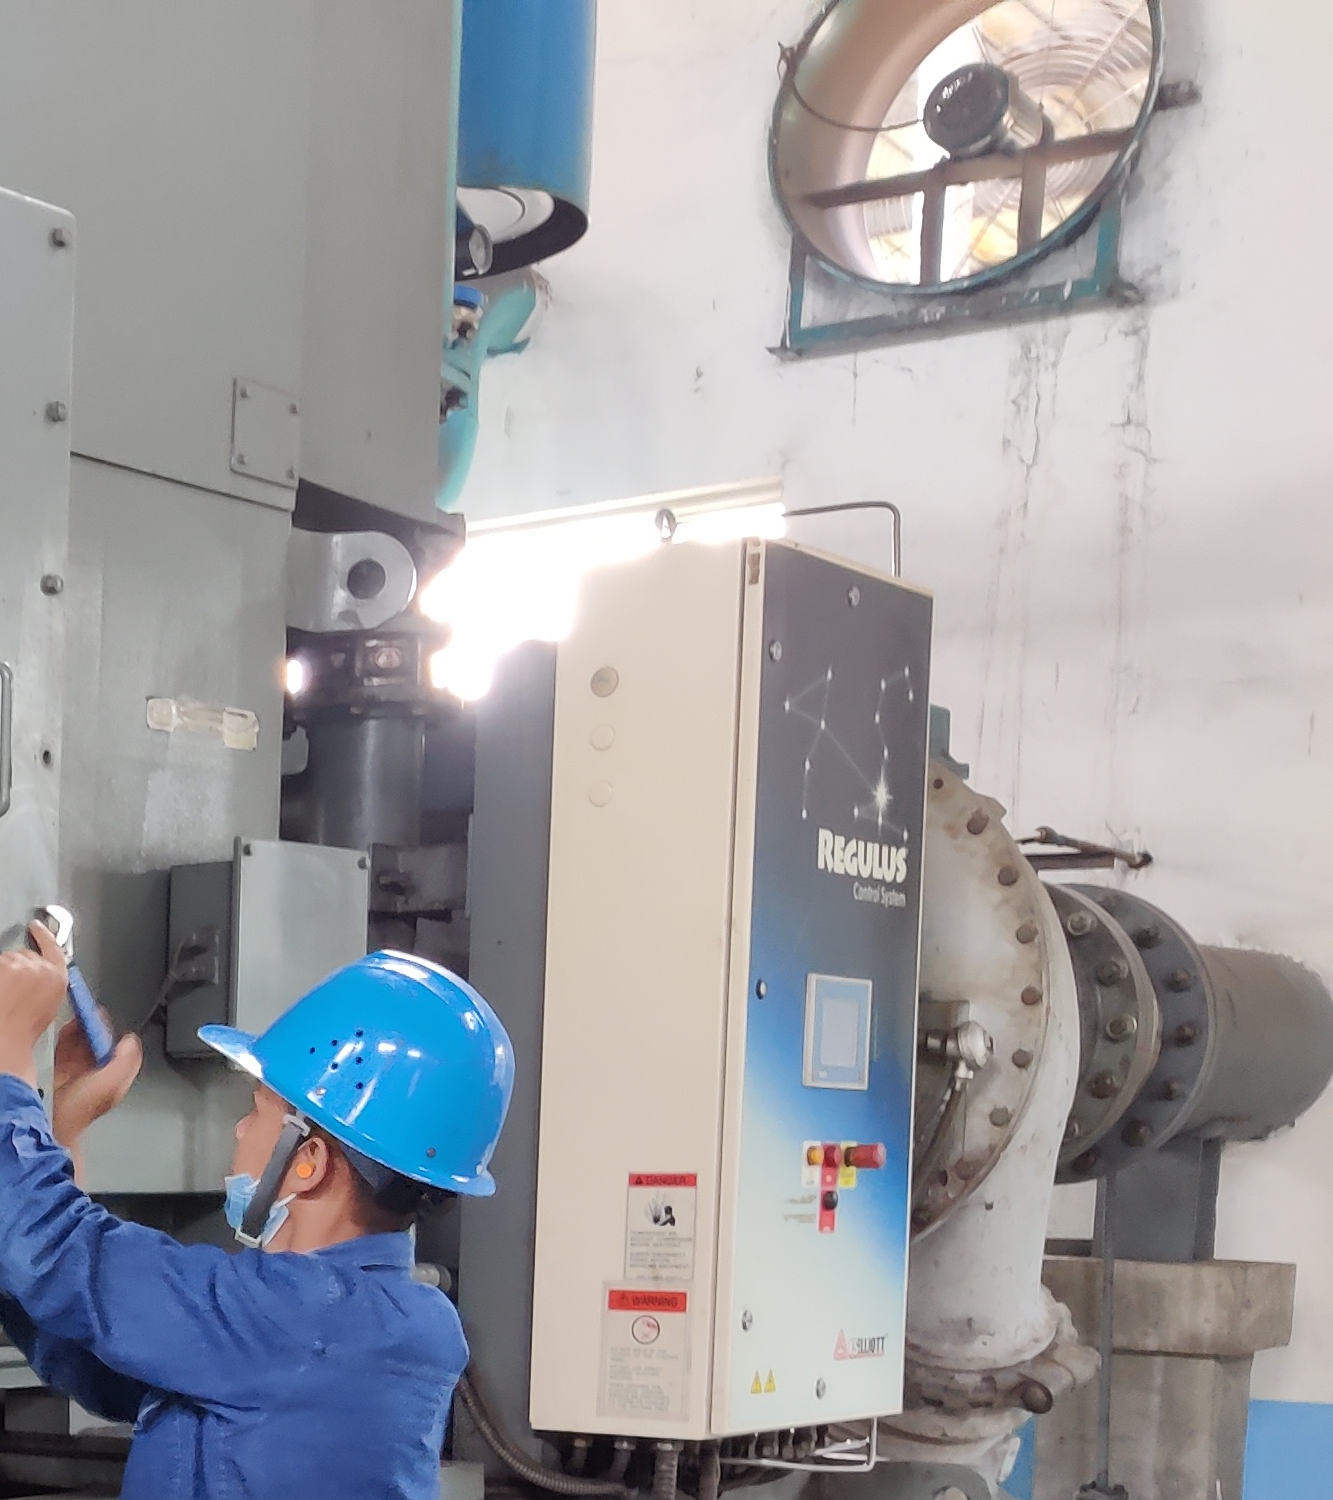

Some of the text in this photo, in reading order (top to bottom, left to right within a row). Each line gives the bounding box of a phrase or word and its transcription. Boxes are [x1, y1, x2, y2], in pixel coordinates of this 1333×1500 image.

[817, 827, 909, 883] REGULUS
[853, 881, 906, 909] Control System
[632, 1295, 678, 1308] WARNING
